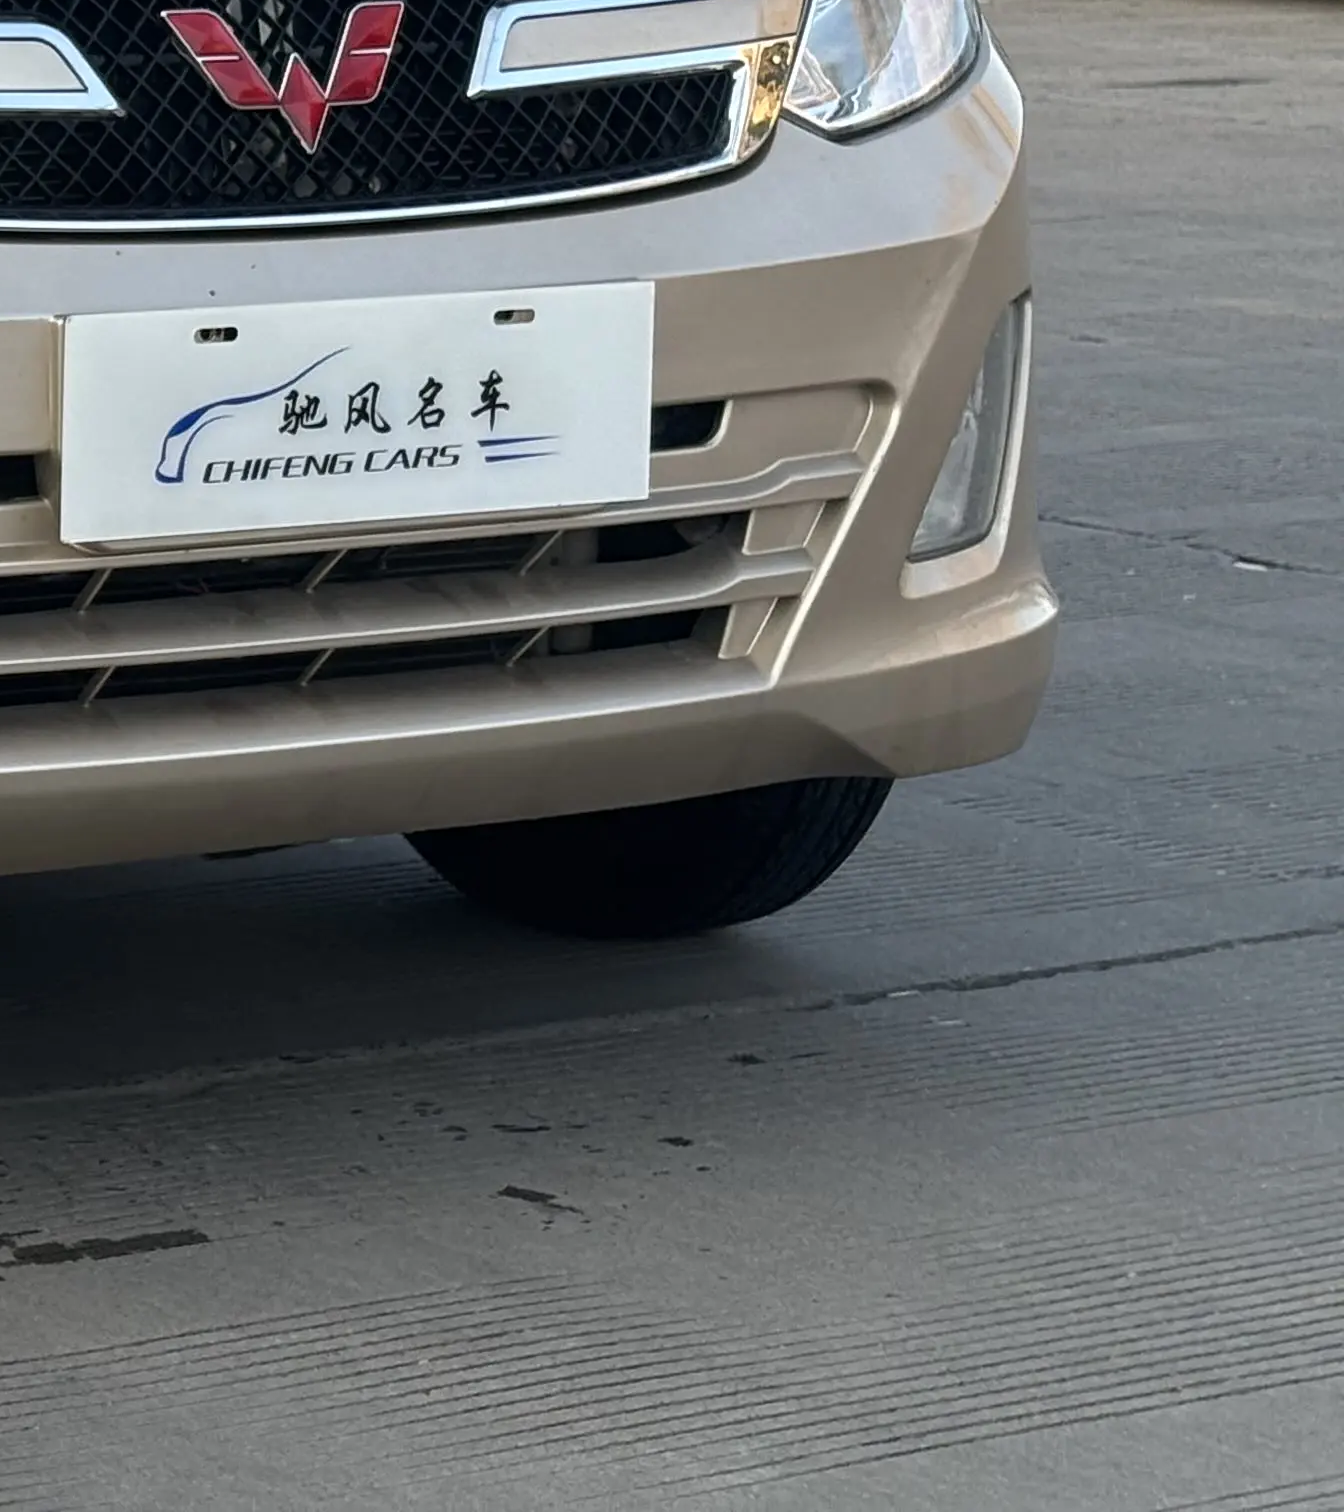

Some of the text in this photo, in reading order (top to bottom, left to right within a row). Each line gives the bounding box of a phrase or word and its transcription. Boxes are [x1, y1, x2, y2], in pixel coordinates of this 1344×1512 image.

[278, 369, 511, 434] 驰风名车
[202, 444, 463, 485] CHIFENG CARS
